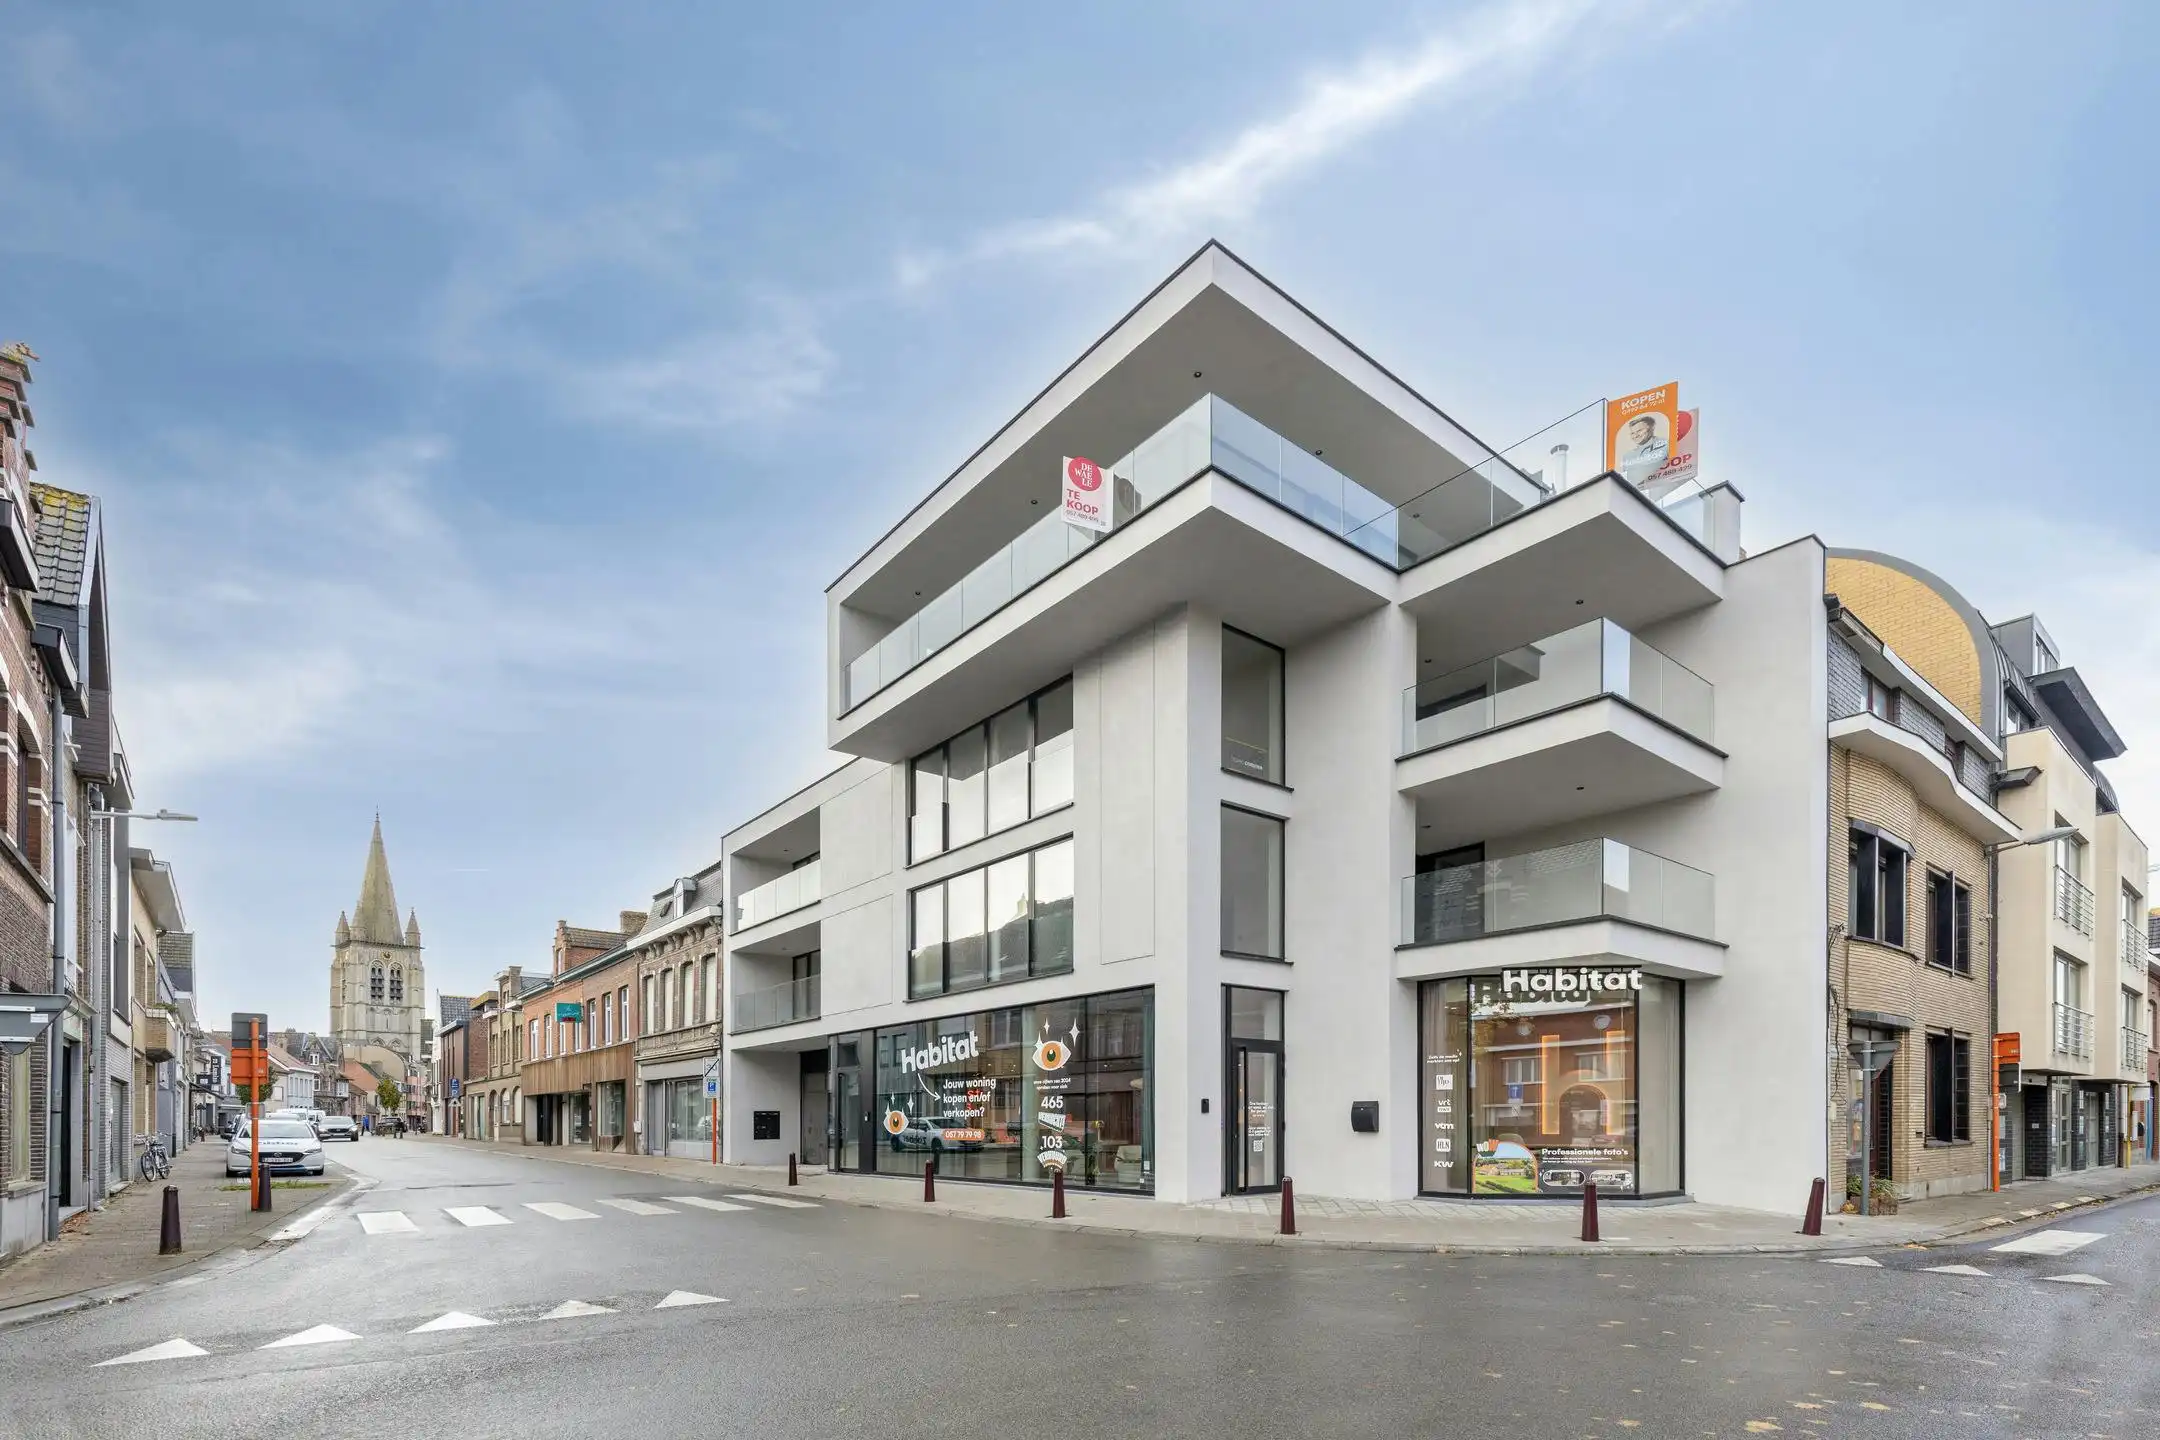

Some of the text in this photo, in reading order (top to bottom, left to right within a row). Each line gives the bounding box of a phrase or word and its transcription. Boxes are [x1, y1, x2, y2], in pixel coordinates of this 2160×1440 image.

[1621, 389, 1666, 411] KOPEN
[1075, 468, 1092, 480] WAE
[1081, 463, 1092, 472] DE
[1648, 472, 1662, 480] 057
[1066, 488, 1081, 500] TE
[1066, 500, 1099, 515] KOOP
[1502, 967, 1642, 992] Habitat
[901, 1030, 979, 1073] Habitat
[943, 1076, 996, 1089] Jouw woning
[943, 1093, 967, 1106] kopen
[968, 1091, 990, 1102] en/of
[1041, 1096, 1064, 1108] 465
[943, 1106, 985, 1120] verkopen?
[1042, 1136, 1062, 1148] 103
[1476, 1138, 1500, 1152] WOW
